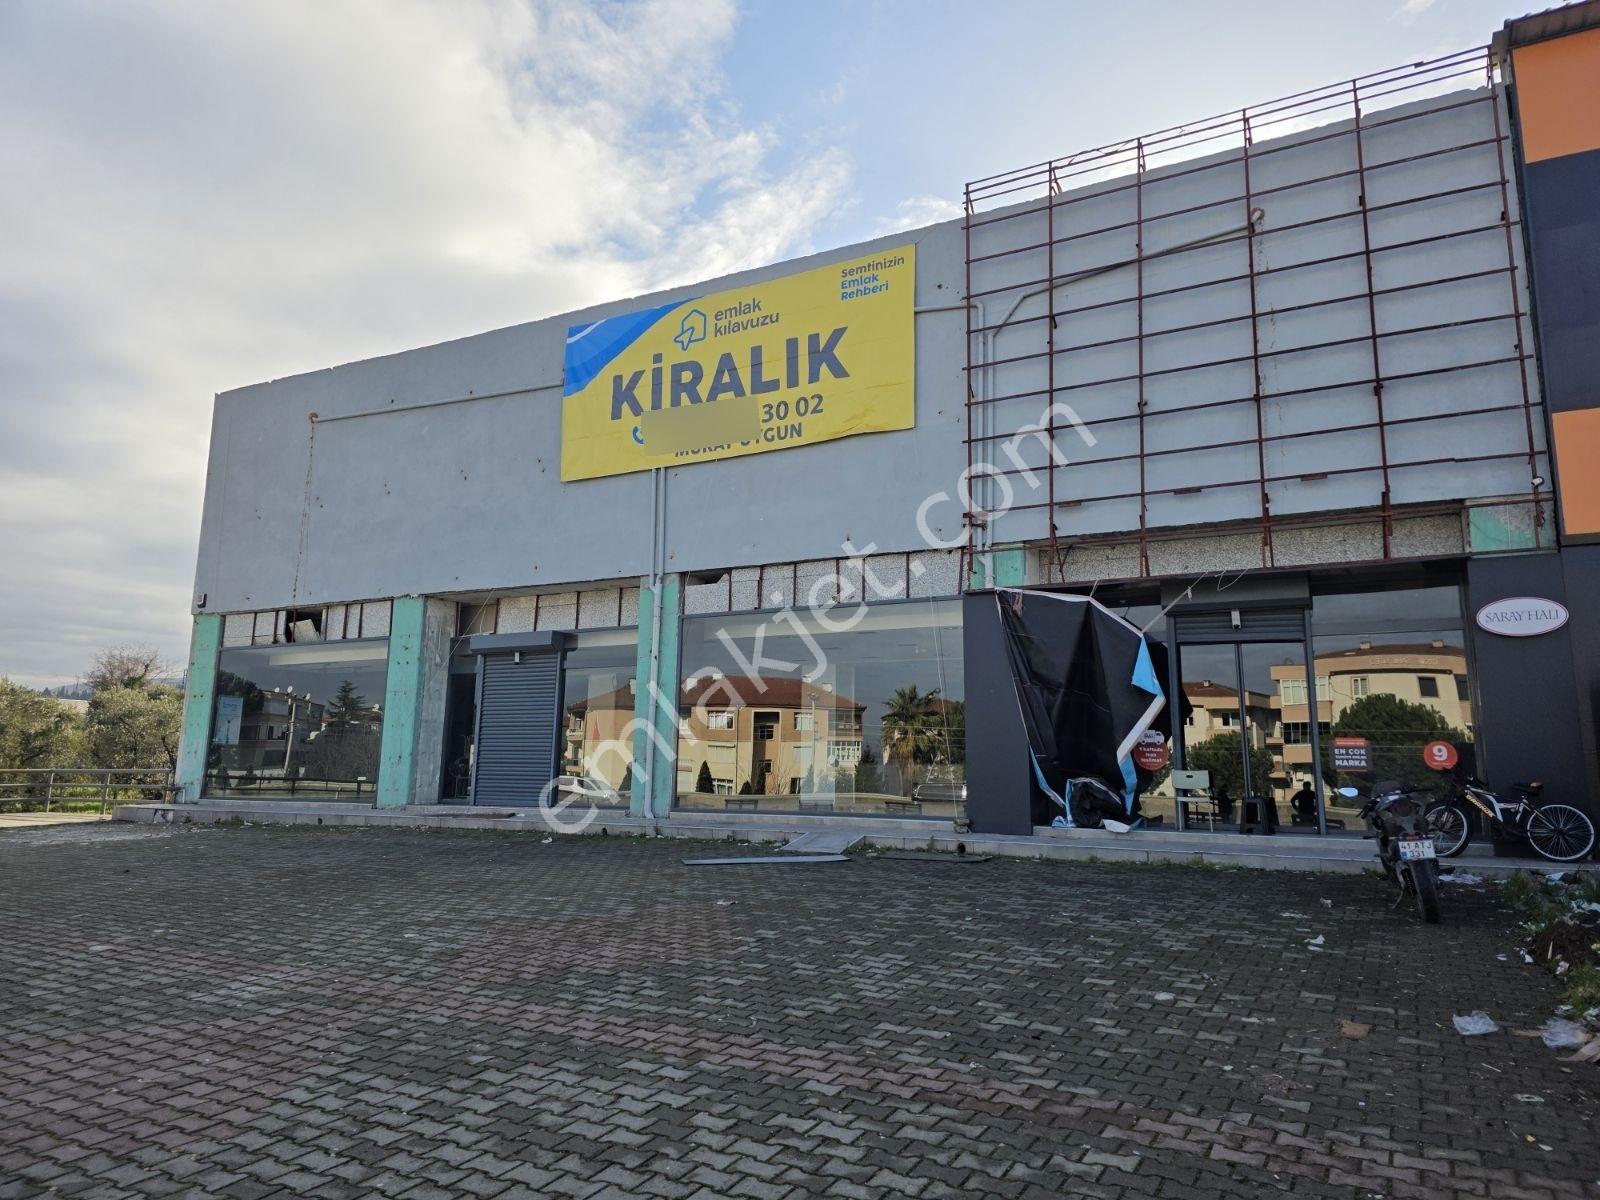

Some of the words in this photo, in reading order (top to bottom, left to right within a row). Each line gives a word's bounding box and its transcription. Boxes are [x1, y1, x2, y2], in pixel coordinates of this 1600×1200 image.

[841, 273, 879, 289] Emlak
[841, 280, 889, 300] Rehberi
[714, 297, 762, 321] emlak
[714, 312, 780, 337] kılavuzu
[610, 326, 850, 421] KİRALIK
[761, 400, 789, 423] 30
[795, 393, 824, 417] 02
[1484, 610, 1523, 623] SARAY
[1527, 608, 1559, 621] HALI
[1432, 744, 1448, 761] 9
[1335, 759, 1367, 767] MARKA
